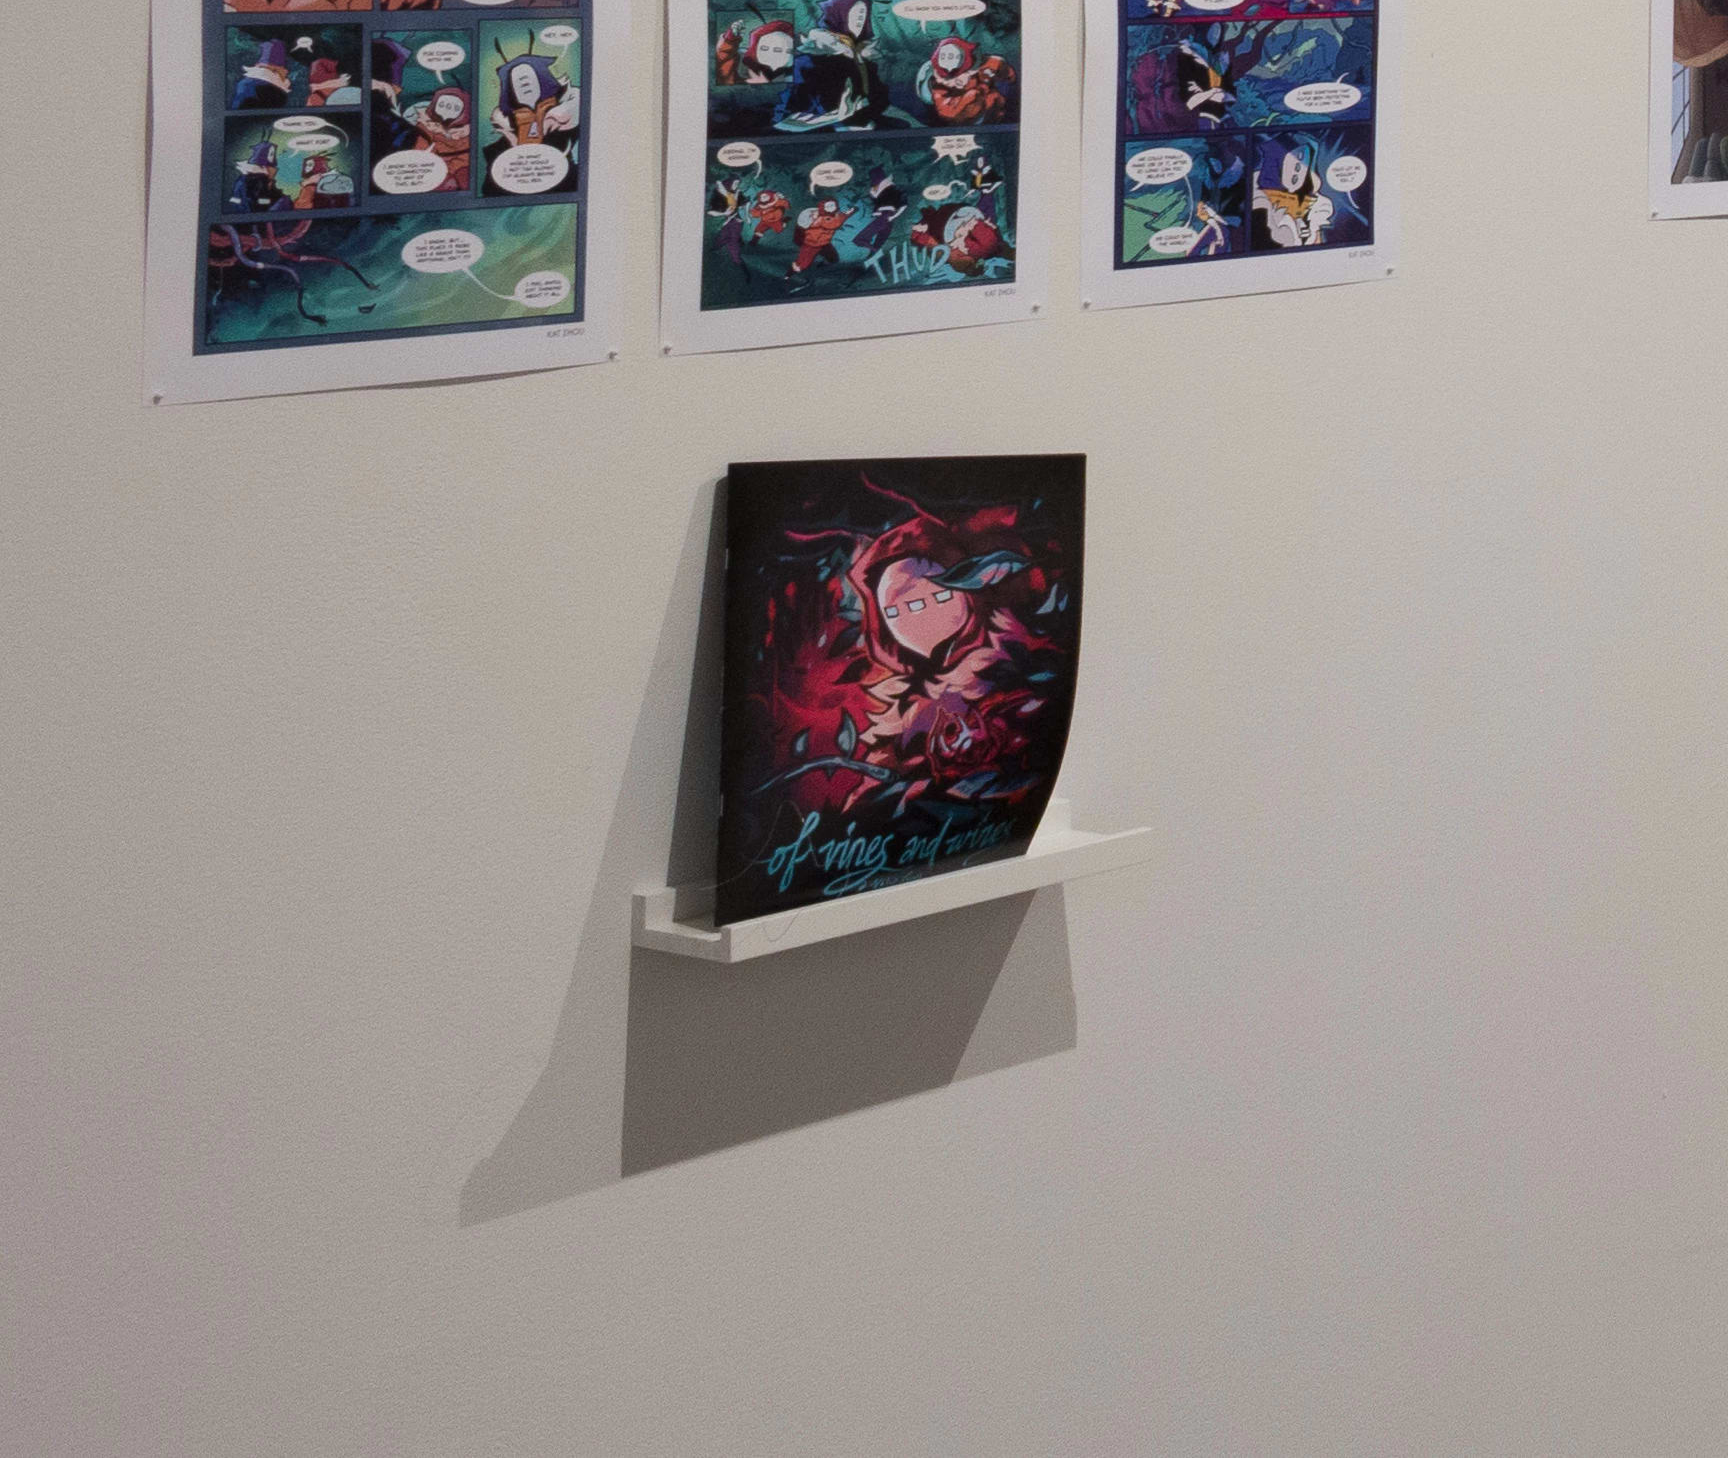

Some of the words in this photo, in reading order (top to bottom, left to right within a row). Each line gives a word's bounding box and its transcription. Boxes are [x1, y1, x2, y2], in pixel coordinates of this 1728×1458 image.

[864, 241, 951, 283] THUD
[765, 811, 820, 893] of
[819, 822, 894, 887] vines
[899, 812, 954, 868] and
